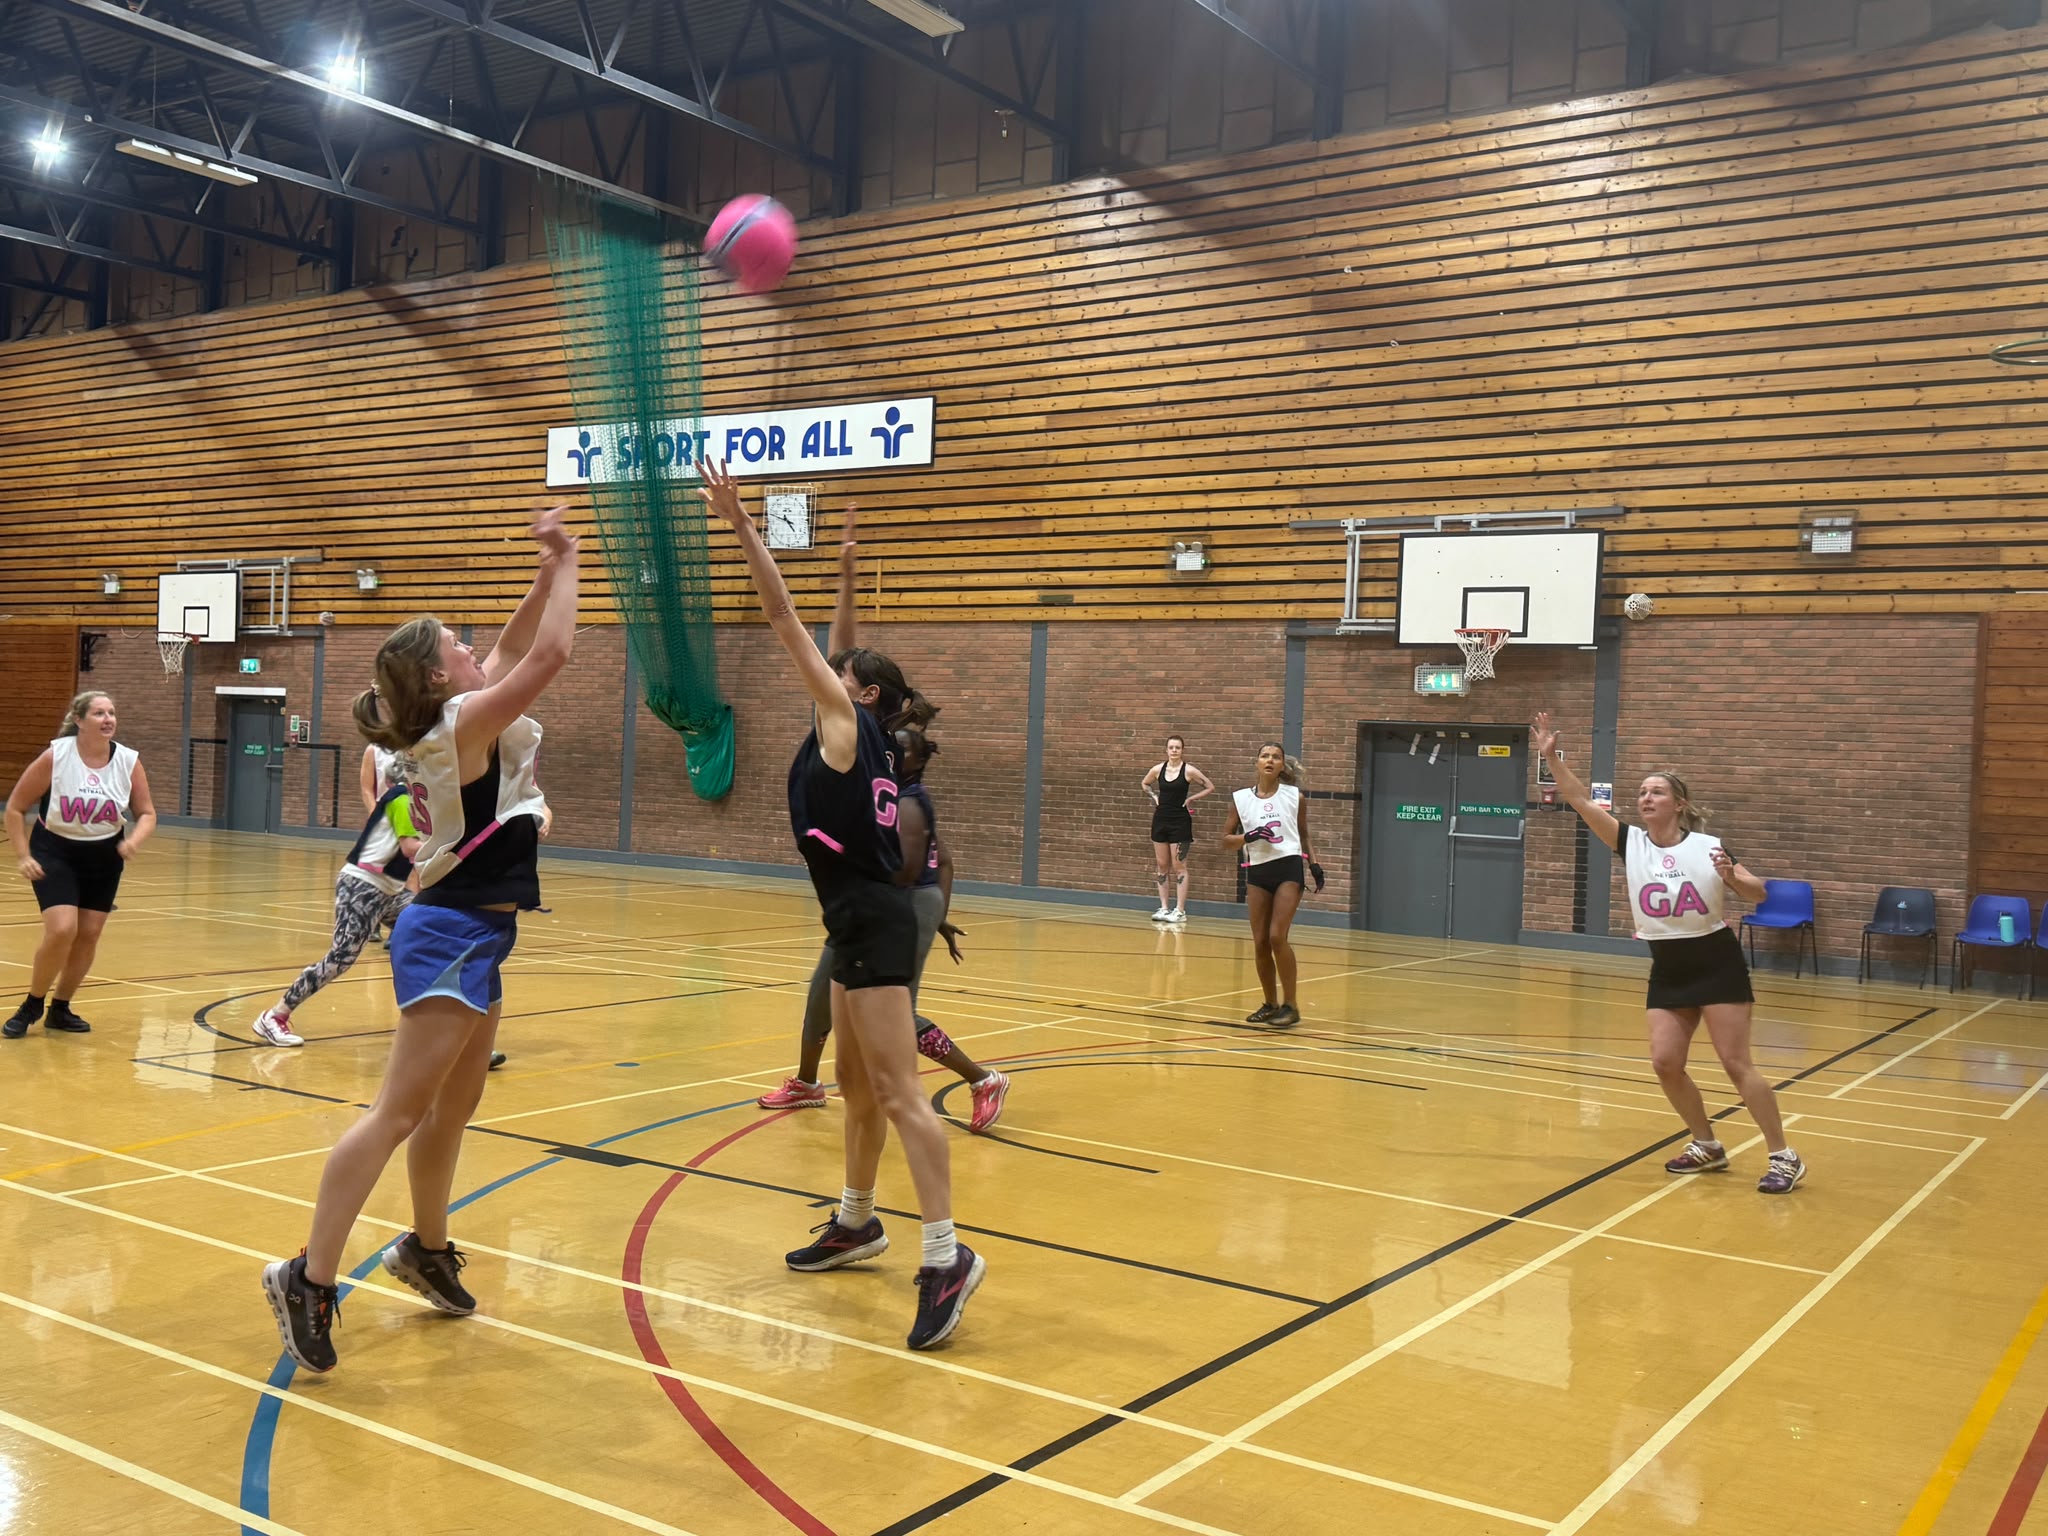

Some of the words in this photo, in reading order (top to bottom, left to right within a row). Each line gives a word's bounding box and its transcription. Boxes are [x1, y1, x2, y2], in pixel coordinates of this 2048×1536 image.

[725, 425, 786, 463] FOR
[801, 419, 853, 459] ALL
[60, 795, 118, 824] WA
[1396, 812, 1416, 820] KEEP
[1416, 813, 1442, 821] CLEAR
[1402, 805, 1419, 813] FIRE
[1420, 806, 1436, 814] EXIT
[1460, 805, 1477, 813] PUSH
[1503, 807, 1520, 815] OPEN
[1639, 880, 1710, 918] GA
